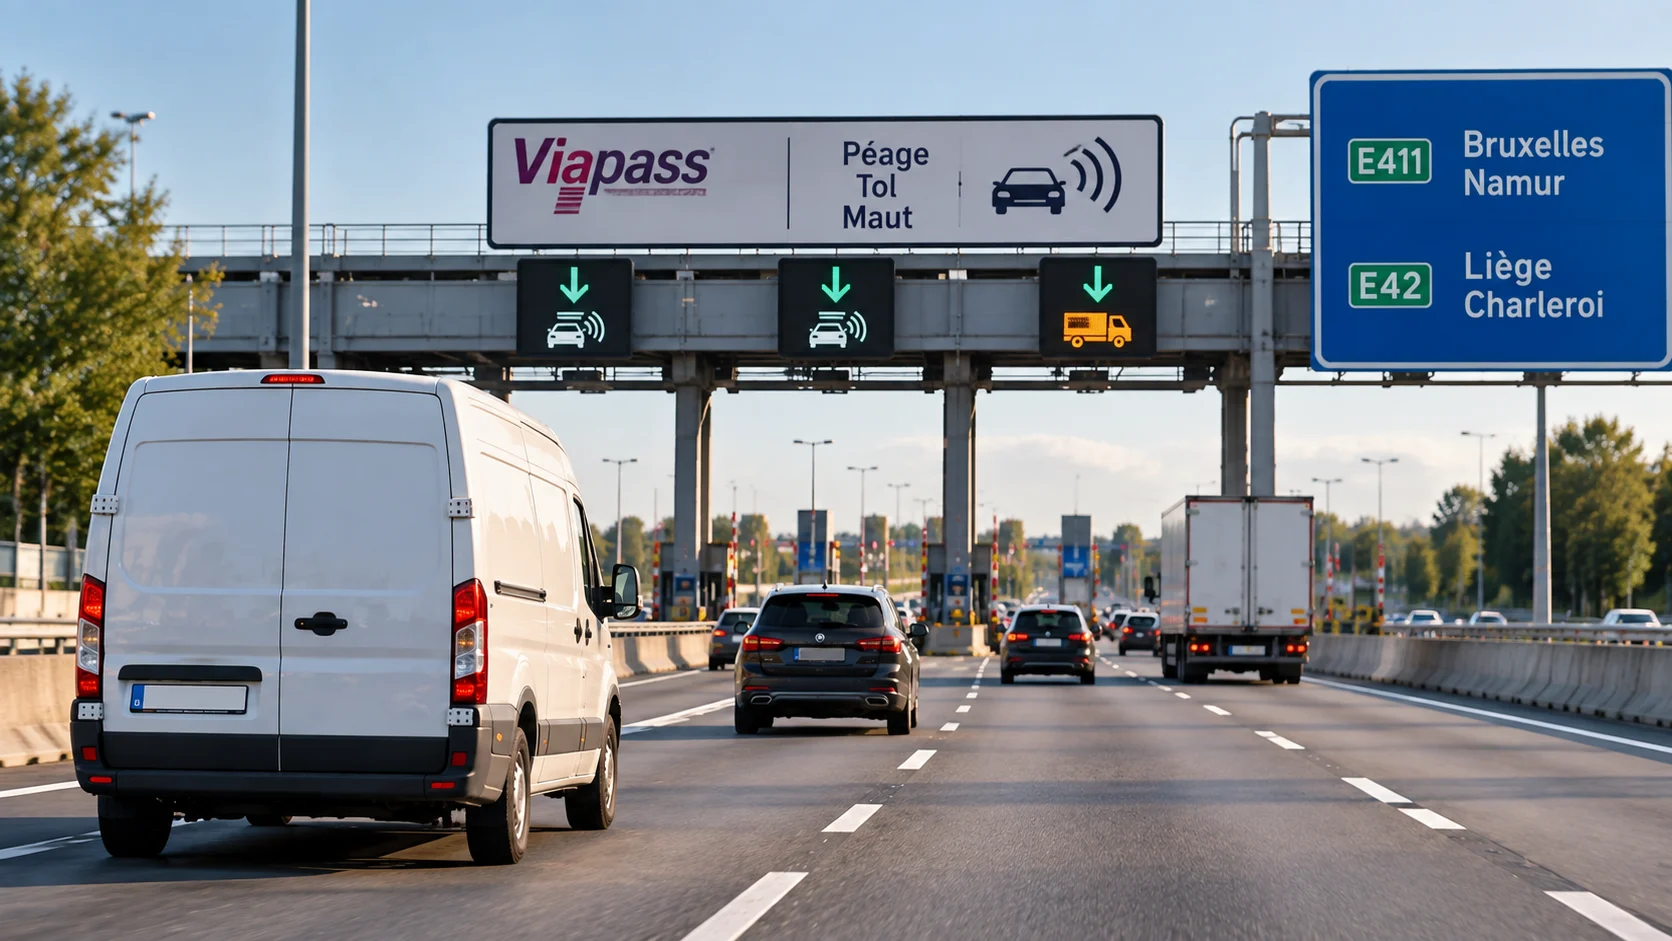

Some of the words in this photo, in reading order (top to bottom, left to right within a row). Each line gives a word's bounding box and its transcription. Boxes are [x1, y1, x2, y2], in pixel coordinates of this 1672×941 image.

[843, 141, 930, 171] Péage
[1464, 130, 1604, 158] Bruxelles
[514, 137, 710, 196] Viapass
[1358, 147, 1421, 175] E411
[856, 173, 897, 198] Tol
[1464, 169, 1565, 196] Namur
[843, 204, 913, 230] Maut
[1465, 251, 1552, 286] Liège
[1360, 271, 1421, 299] E42
[1464, 290, 1604, 318] Charleroi
